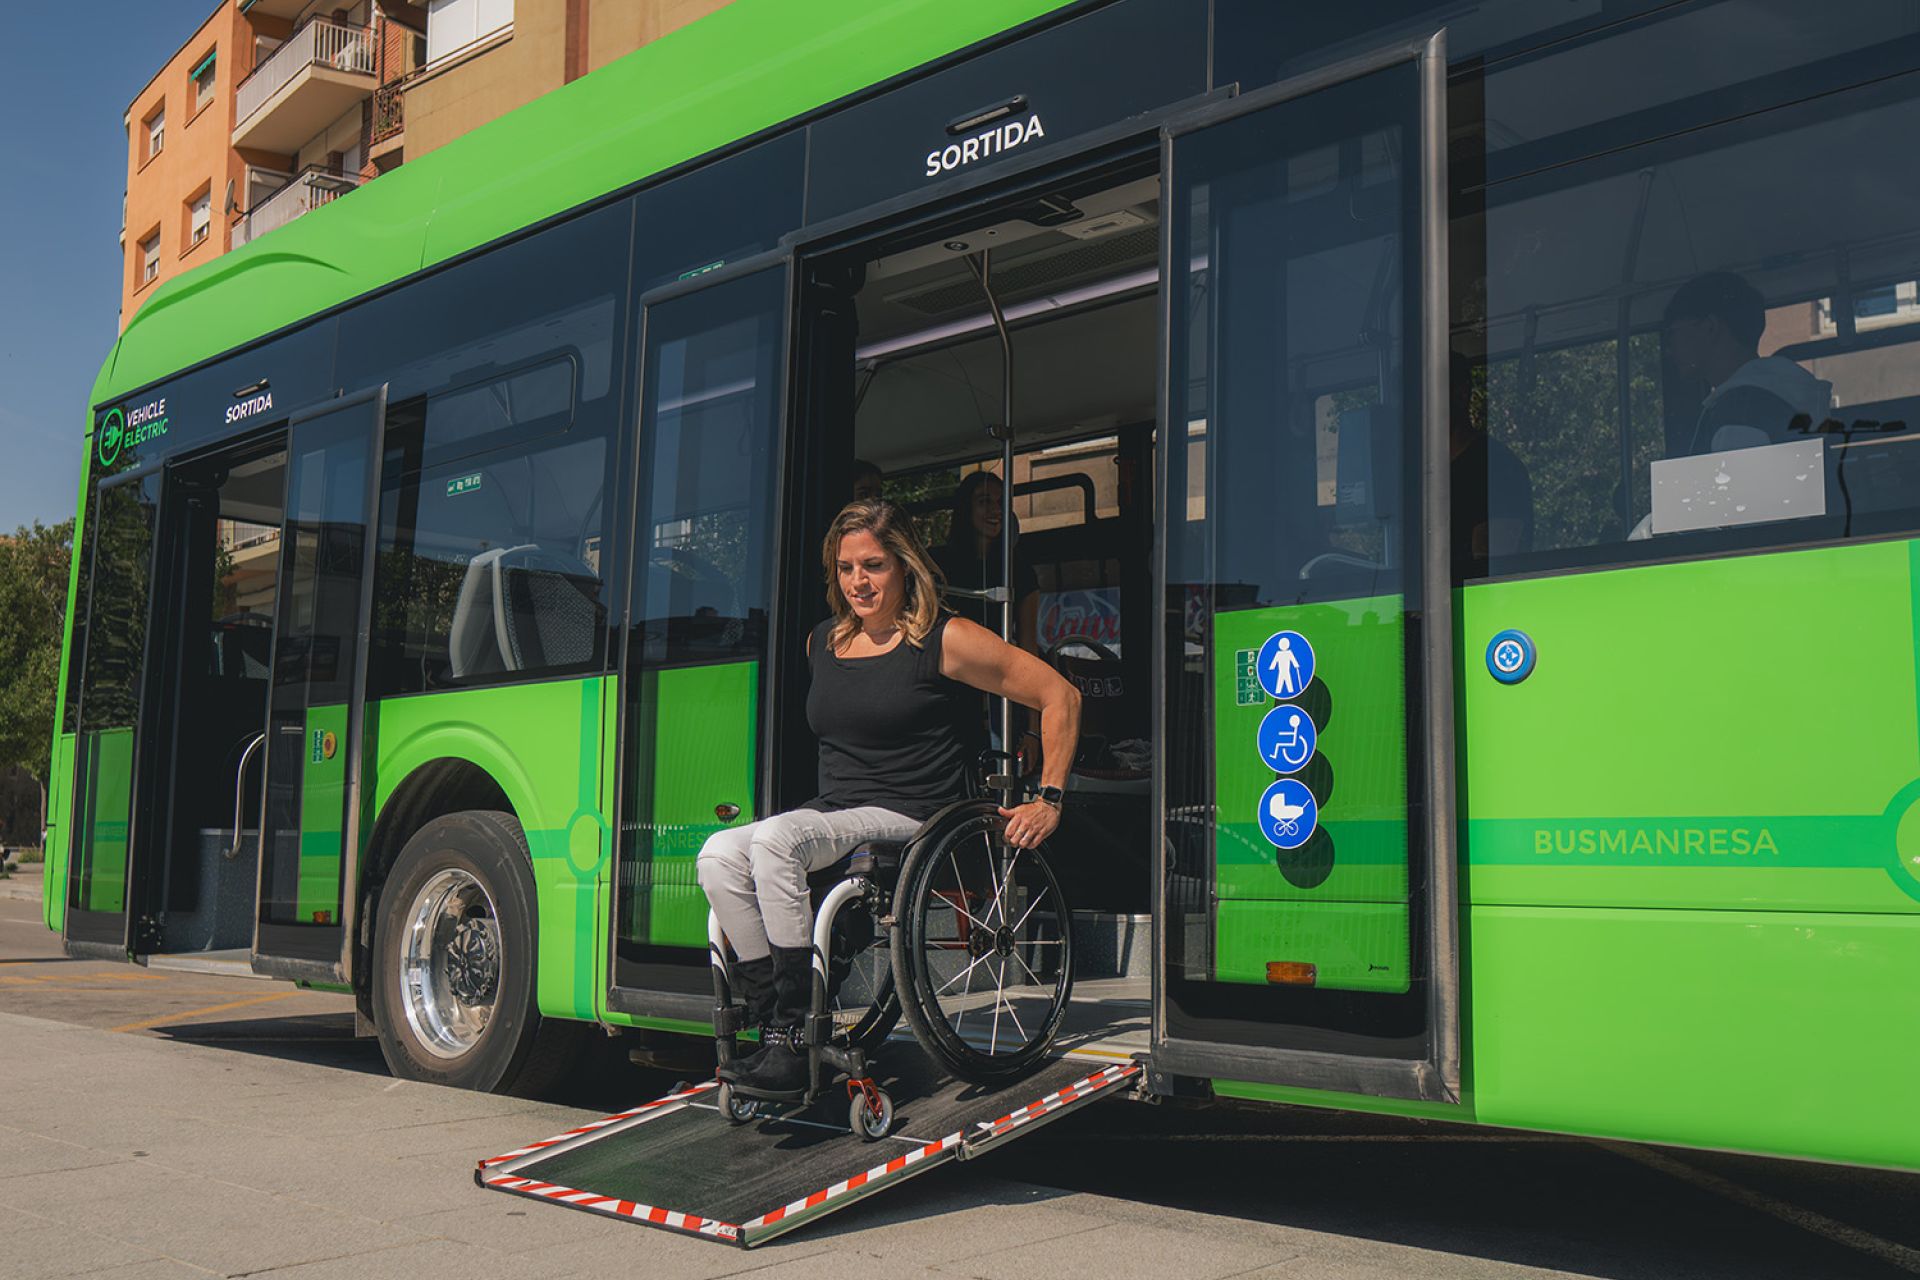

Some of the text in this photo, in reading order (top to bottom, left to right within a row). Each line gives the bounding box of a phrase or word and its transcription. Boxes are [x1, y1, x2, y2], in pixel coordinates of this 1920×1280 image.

[926, 114, 1045, 177] SORTIDA
[127, 398, 166, 428] VEHICLE
[225, 392, 273, 424] SORTIDA
[1534, 828, 1780, 855] BUSMANRESA
